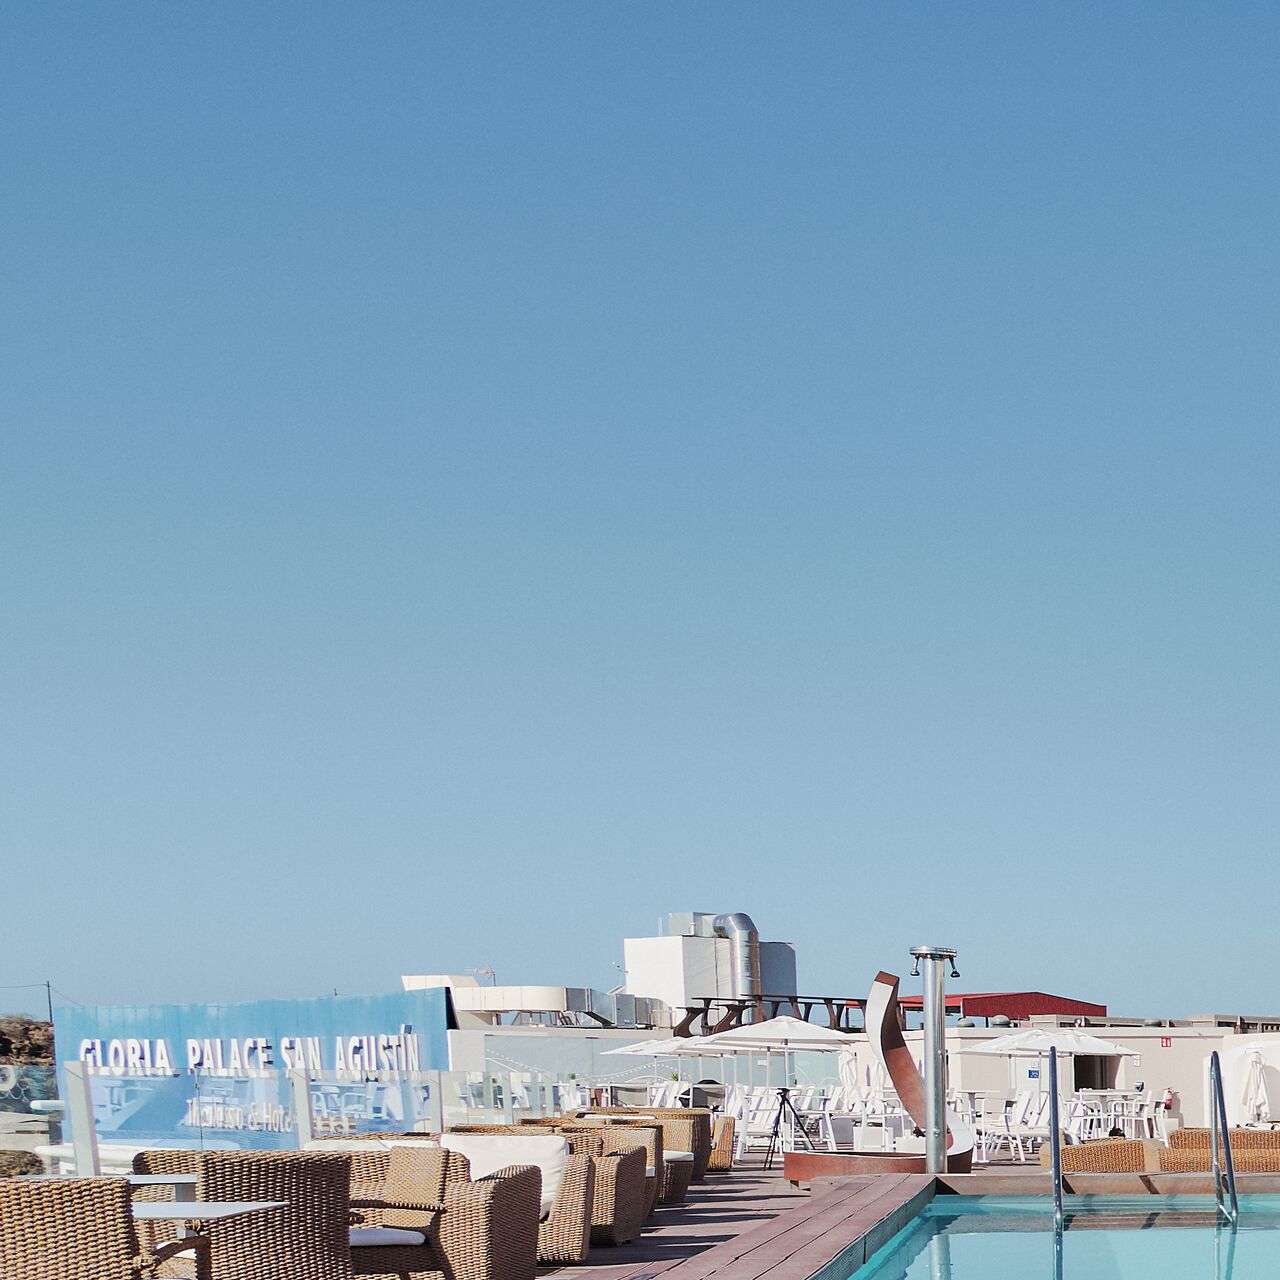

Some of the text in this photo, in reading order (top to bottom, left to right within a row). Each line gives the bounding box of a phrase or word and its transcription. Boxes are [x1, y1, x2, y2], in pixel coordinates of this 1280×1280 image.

[80, 1039, 172, 1076] GLORIA
[187, 1038, 271, 1078] PALACE
[281, 1037, 321, 1079] SAN
